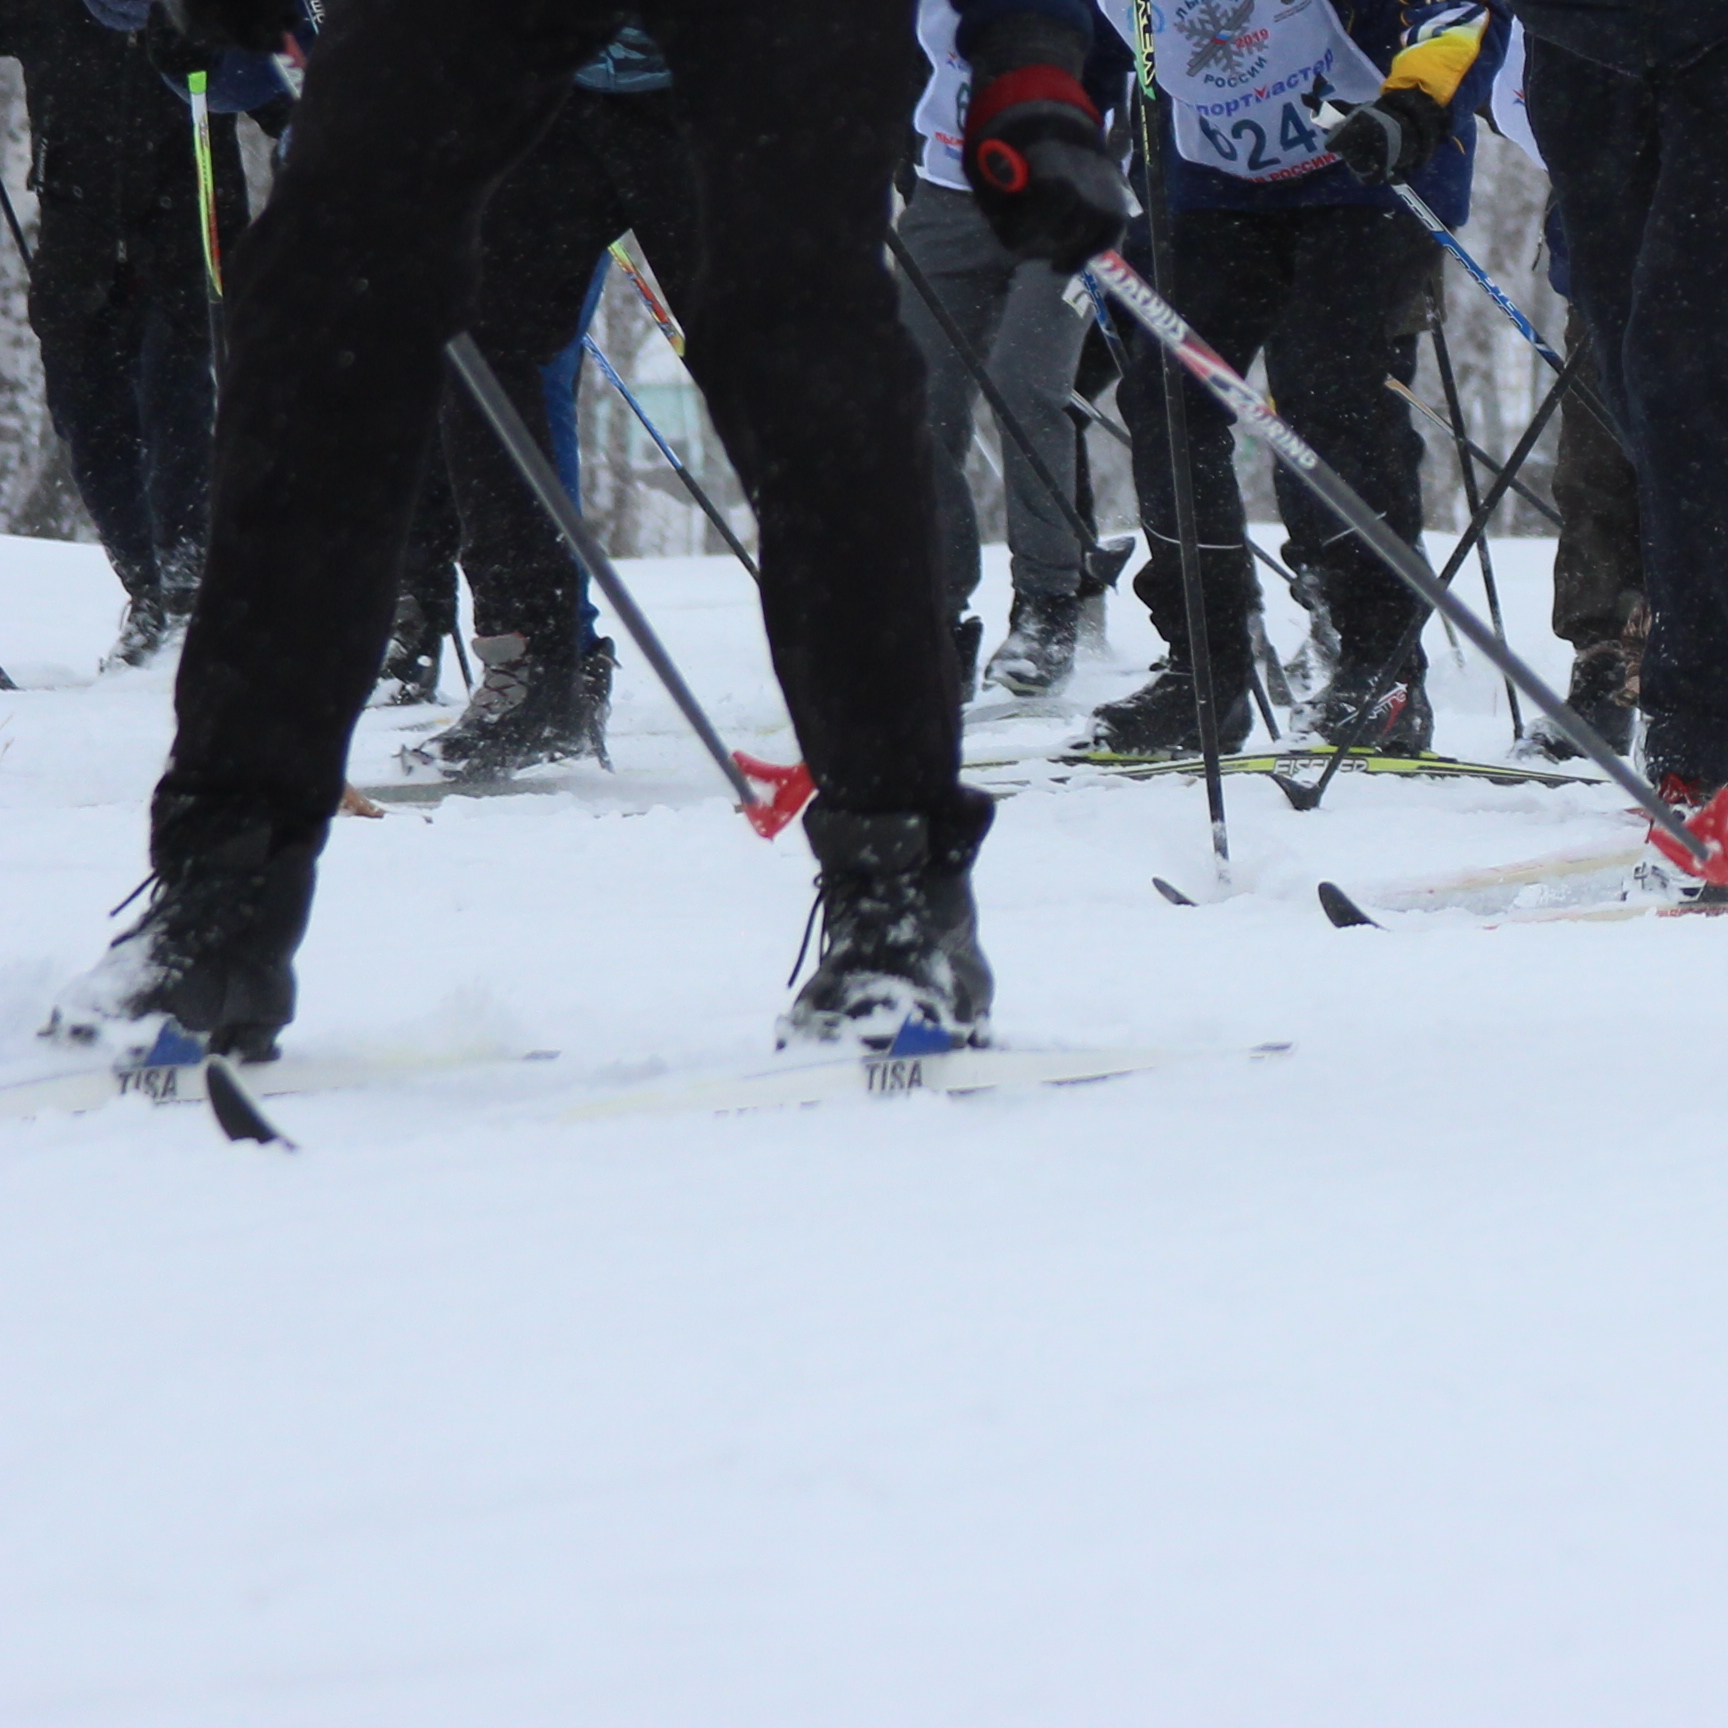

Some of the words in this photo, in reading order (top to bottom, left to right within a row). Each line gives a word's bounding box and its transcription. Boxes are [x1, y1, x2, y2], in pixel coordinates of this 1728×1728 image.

[1234, 28, 1270, 48] 2019
[1204, 55, 1268, 89] РОССИИ
[1199, 83, 1336, 171] 624
[118, 1068, 178, 1098] TISA
[865, 1059, 923, 1091] TISA
